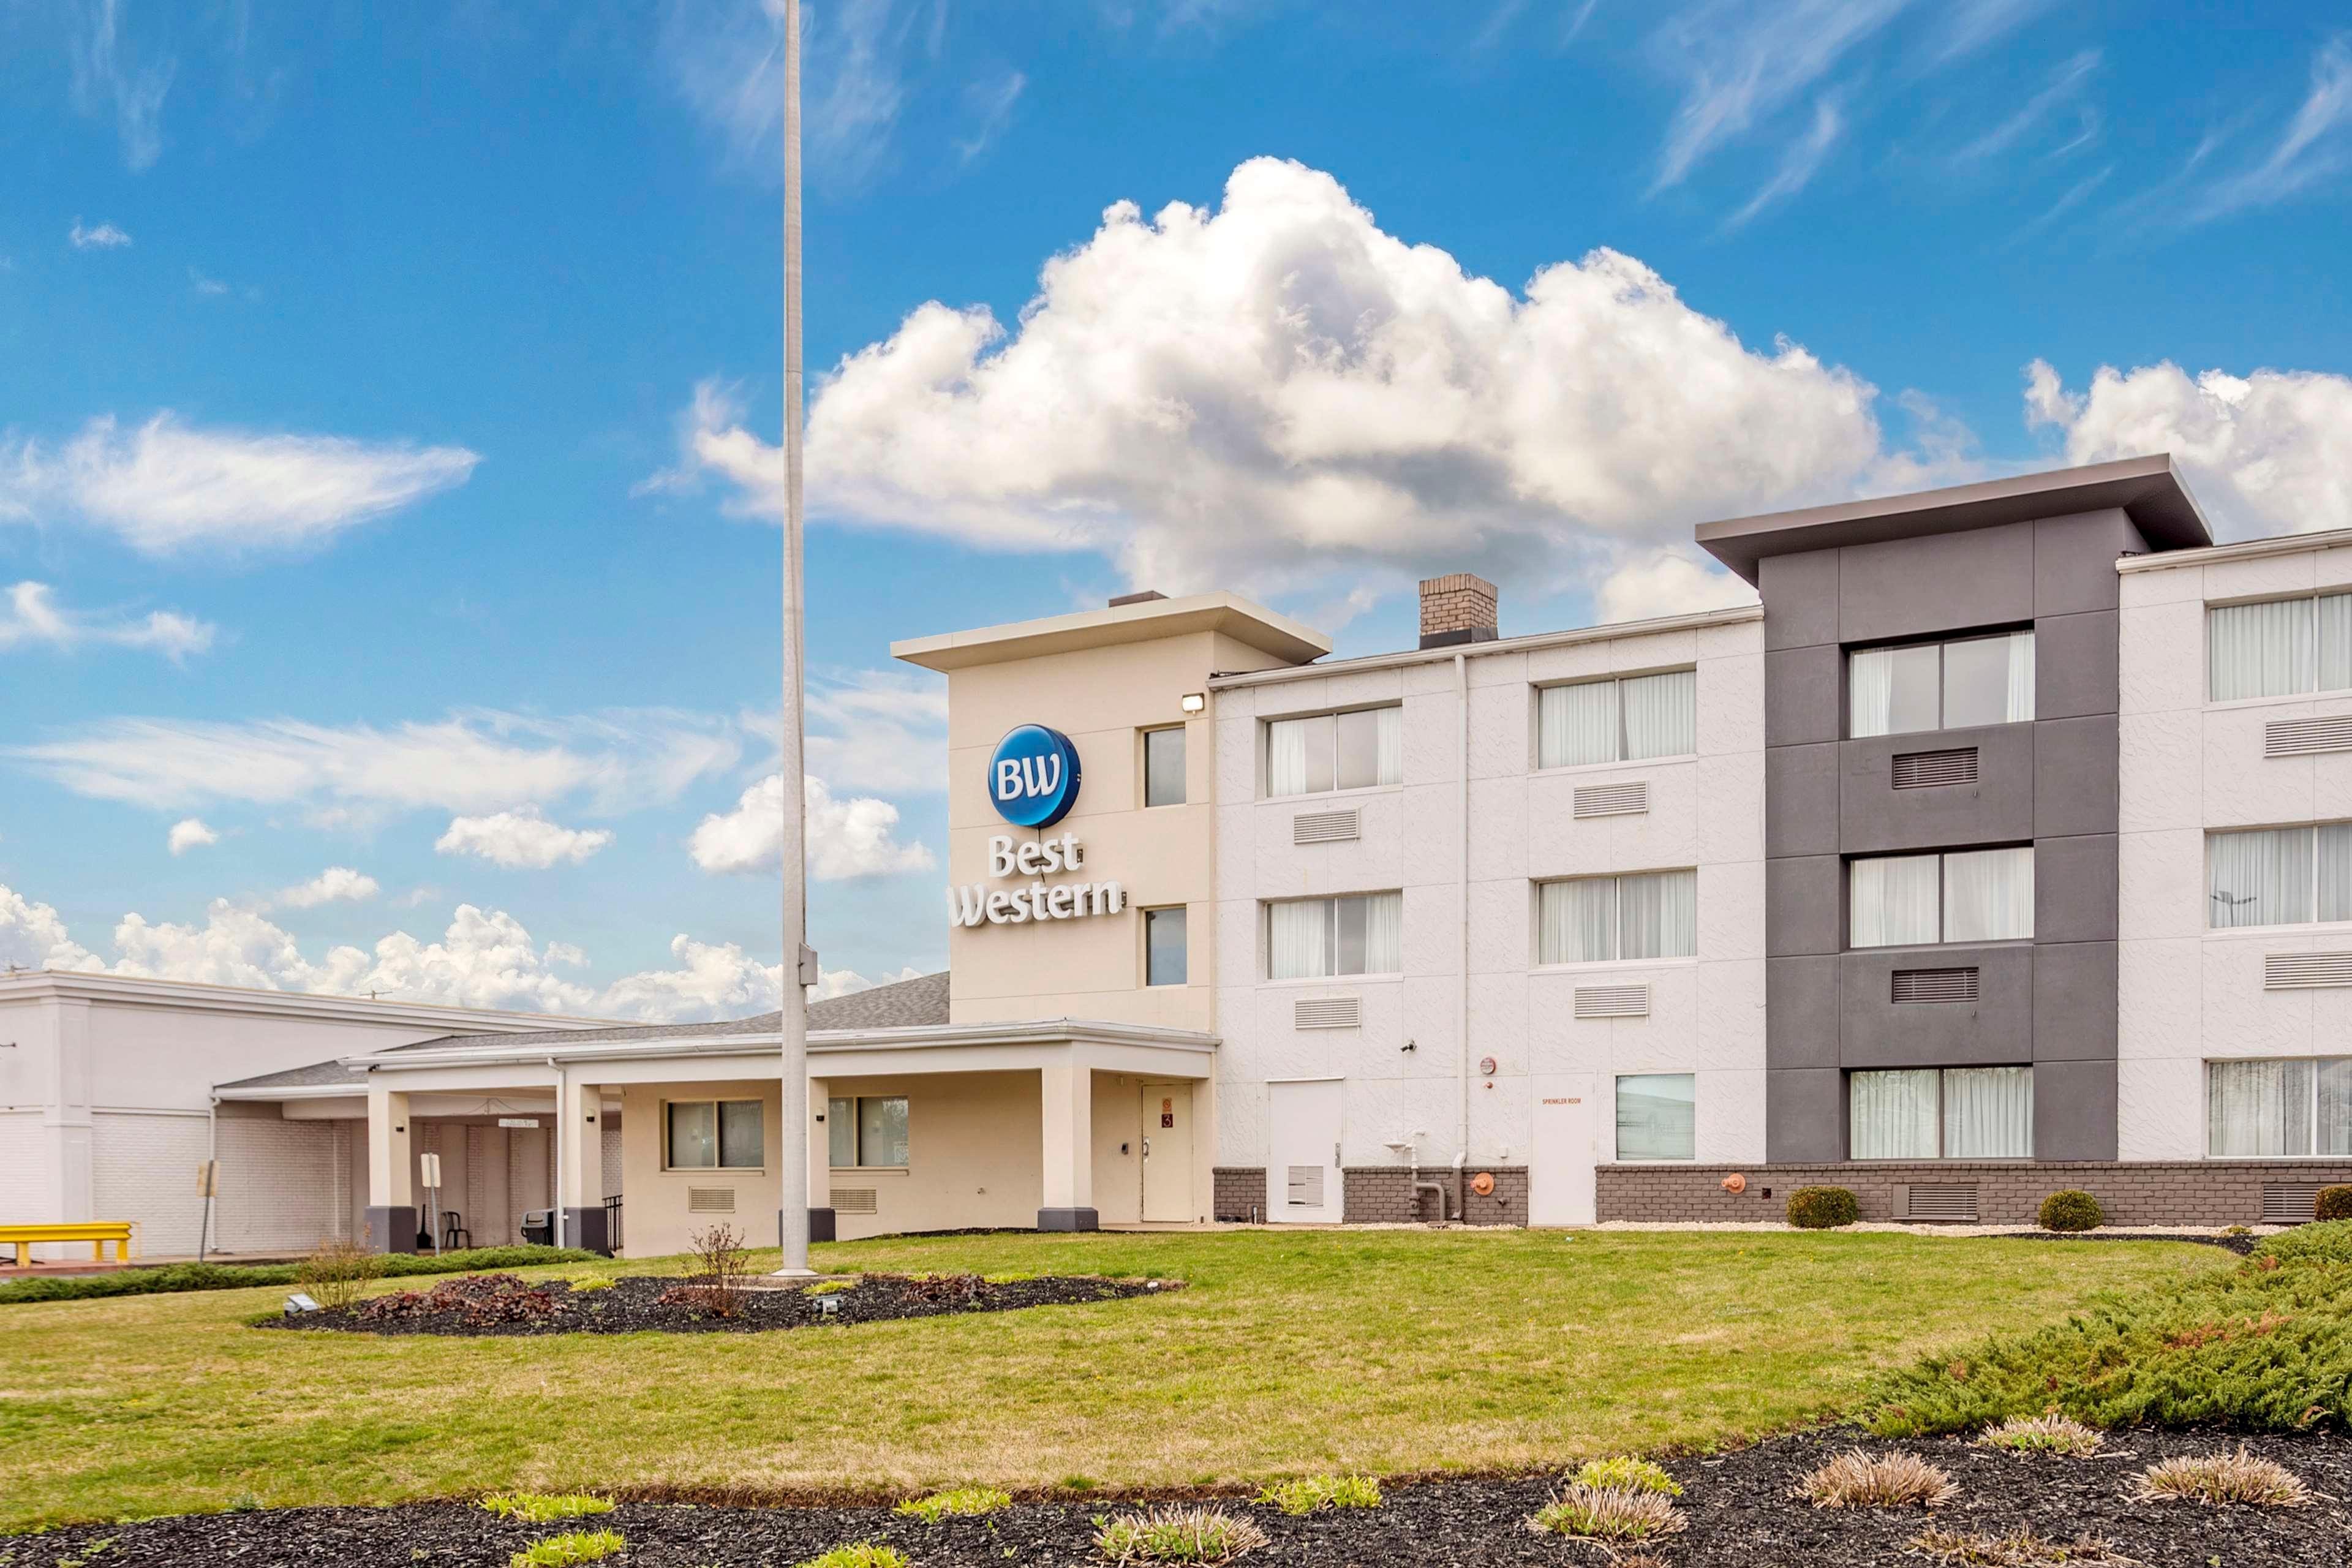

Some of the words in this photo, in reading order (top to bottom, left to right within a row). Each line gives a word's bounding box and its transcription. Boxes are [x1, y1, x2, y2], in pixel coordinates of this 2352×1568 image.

[997, 753, 1060, 800] BW
[989, 832, 1080, 877] Best
[947, 881, 1122, 927] Western
[1164, 1114, 1171, 1127] 3
